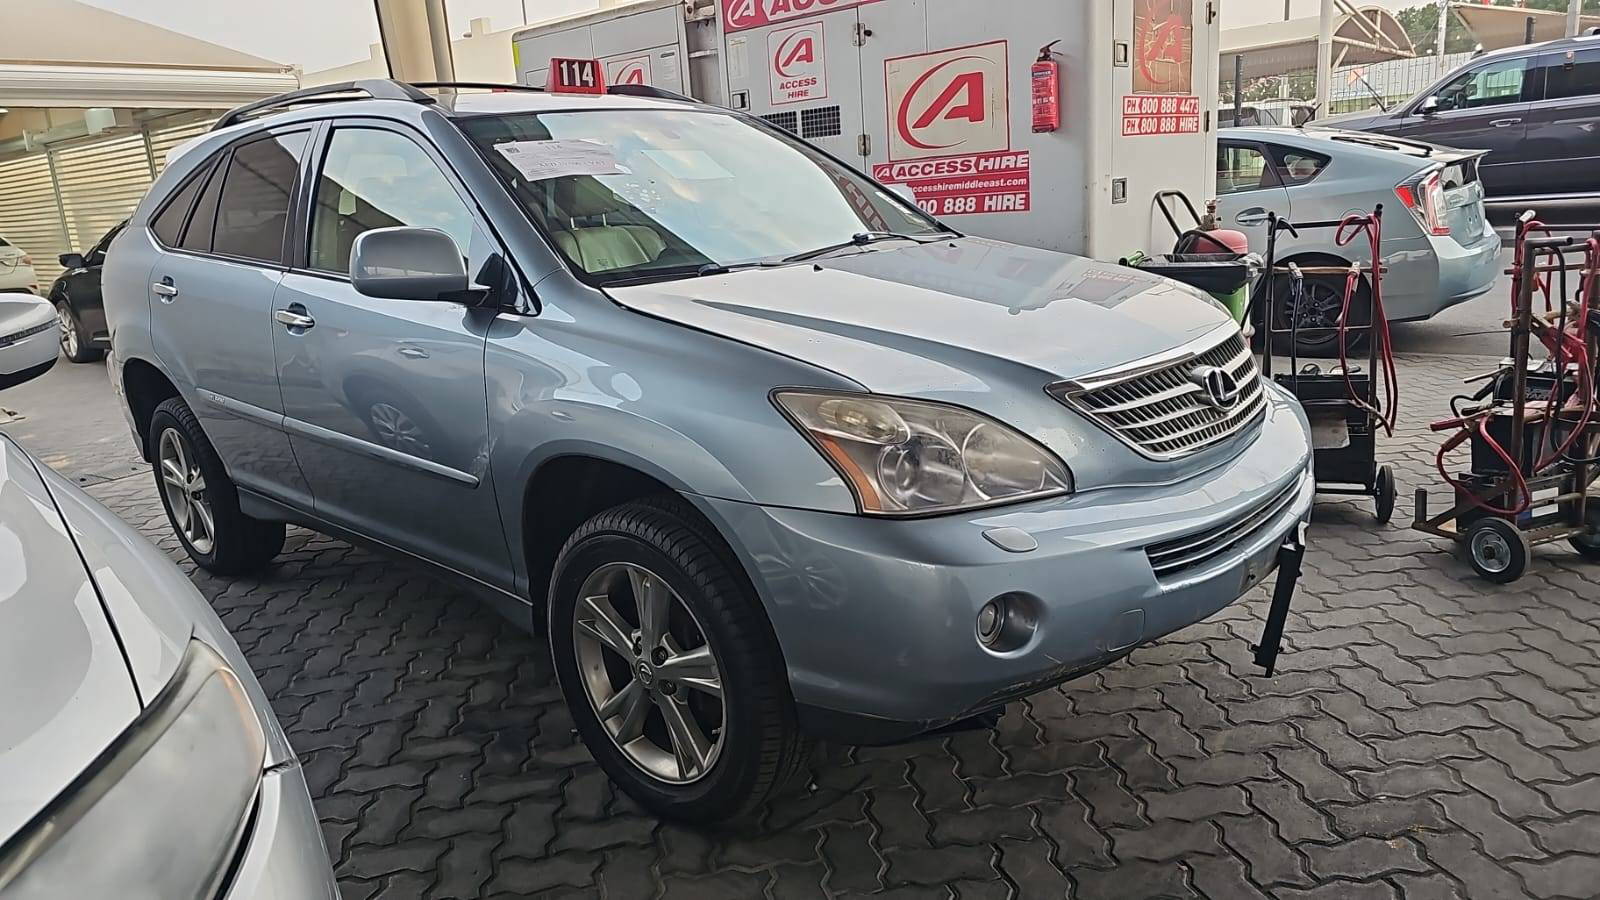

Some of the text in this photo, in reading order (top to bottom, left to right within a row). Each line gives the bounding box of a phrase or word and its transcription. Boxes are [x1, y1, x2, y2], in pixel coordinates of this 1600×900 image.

[560, 61, 594, 87] 114
[779, 77, 817, 90] ACCESS
[787, 90, 809, 99] HIRE
[1141, 98, 1158, 114] 800
[1160, 98, 1177, 114] 888
[1179, 98, 1199, 114] 4473
[1141, 117, 1158, 133] 800
[1160, 117, 1177, 133] 888
[1179, 117, 1198, 132] HIRE
[894, 158, 974, 178] ACCESS
[978, 154, 1028, 171] HIRE
[912, 178, 1026, 193] ccesshiremiddleeast.com
[918, 194, 1026, 214] 00 888 HIRE
